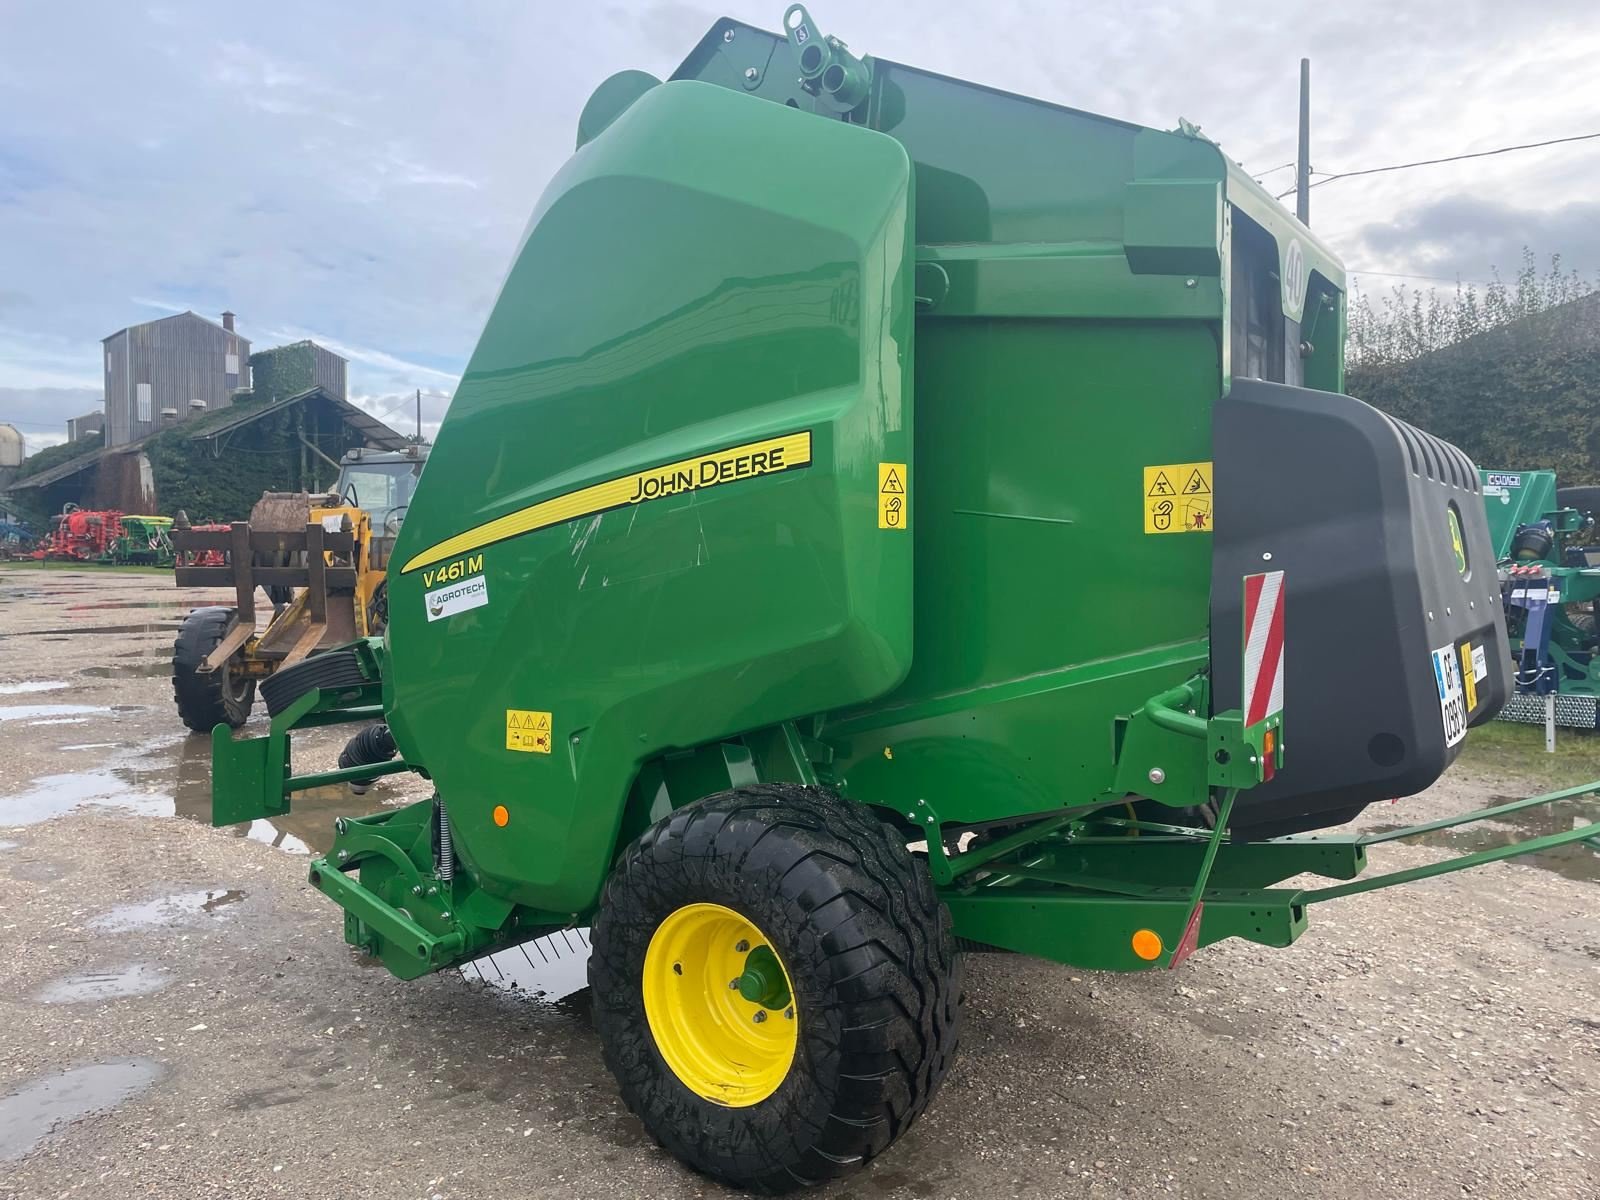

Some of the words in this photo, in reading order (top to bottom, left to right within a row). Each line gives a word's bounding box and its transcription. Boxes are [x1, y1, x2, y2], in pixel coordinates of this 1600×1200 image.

[1287, 245, 1302, 306] 40
[631, 469, 693, 501] JOHN
[700, 447, 785, 484] DEERE
[423, 569, 444, 588] V
[436, 559, 465, 583] 461
[468, 553, 483, 575] M
[436, 581, 485, 605] AGROTECH
